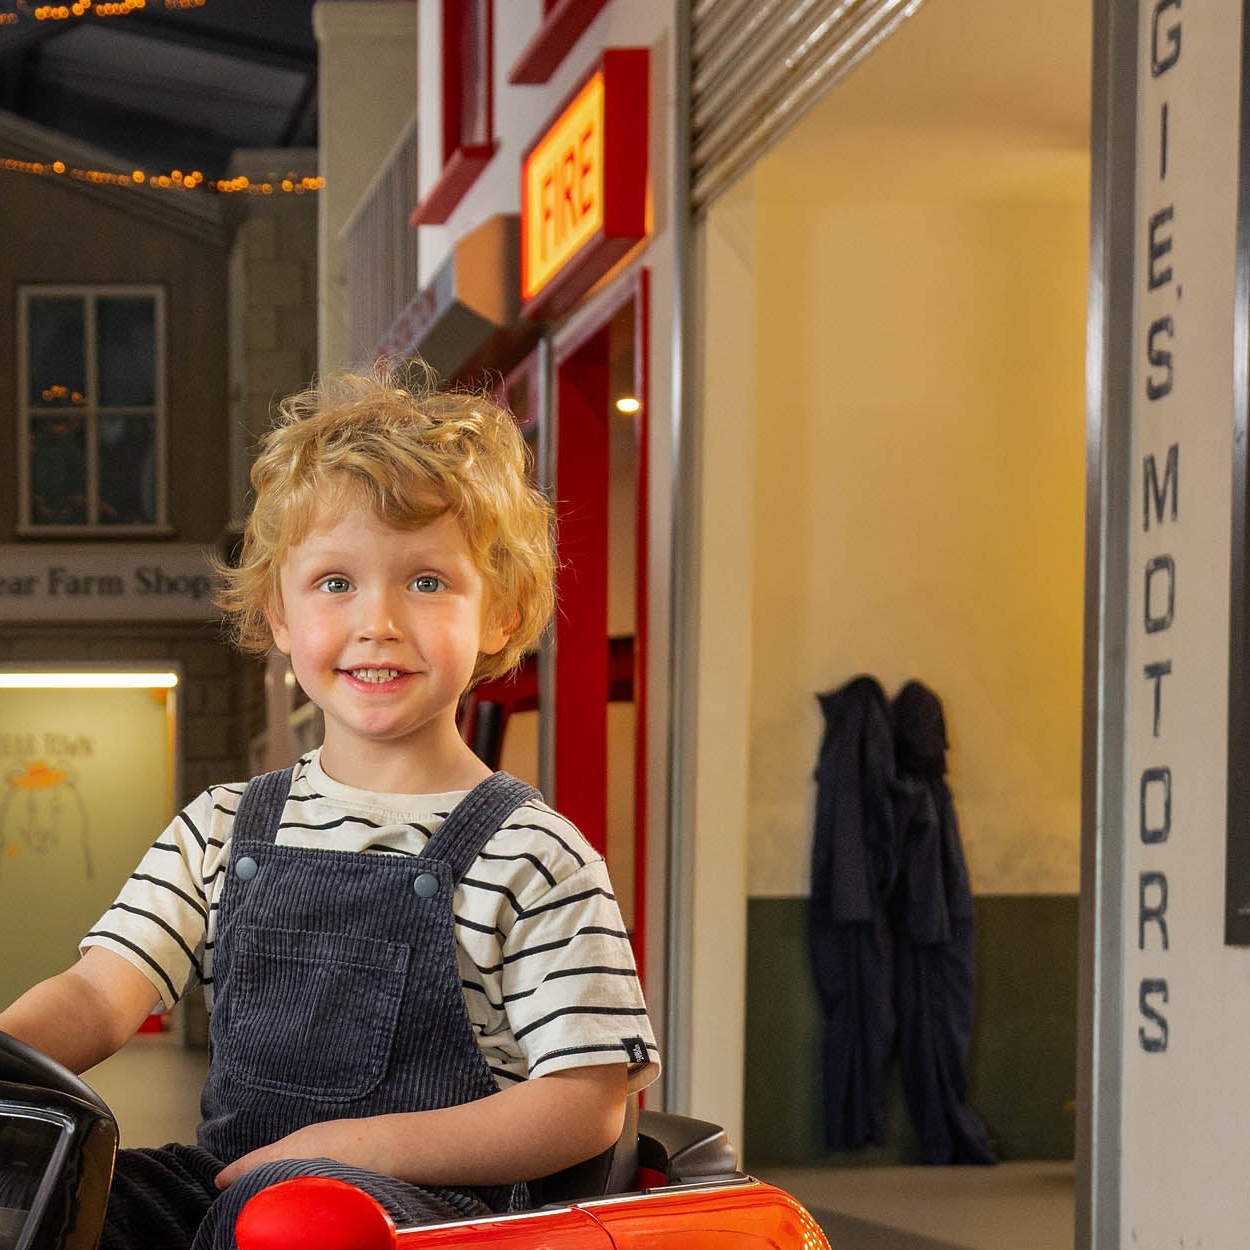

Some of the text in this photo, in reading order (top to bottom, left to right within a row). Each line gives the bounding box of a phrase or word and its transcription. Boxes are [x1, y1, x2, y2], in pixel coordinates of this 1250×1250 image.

[541, 124, 593, 262] FIRE
[48, 565, 126, 597] Farm
[136, 565, 211, 602] Shop
[1138, 443, 1180, 1054] MOTORS
